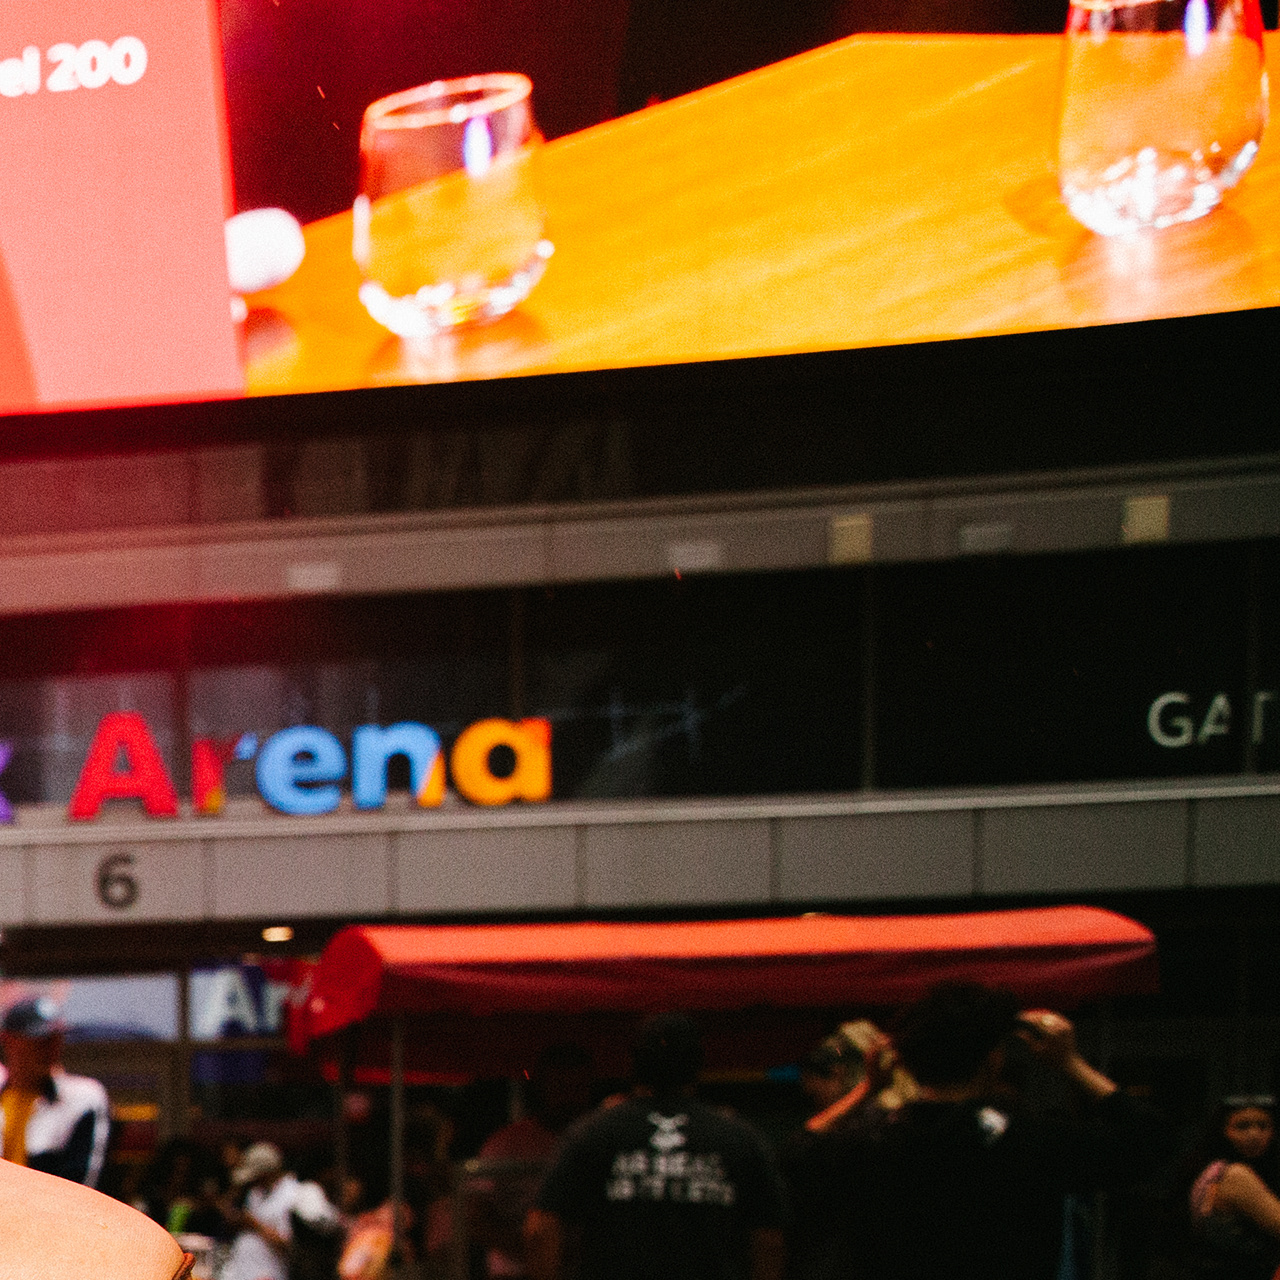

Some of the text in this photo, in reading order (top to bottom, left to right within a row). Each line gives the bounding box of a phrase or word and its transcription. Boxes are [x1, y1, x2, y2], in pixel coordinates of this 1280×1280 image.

[45, 35, 149, 93] 200
[66, 710, 554, 822] Arena
[93, 852, 140, 910] 6
